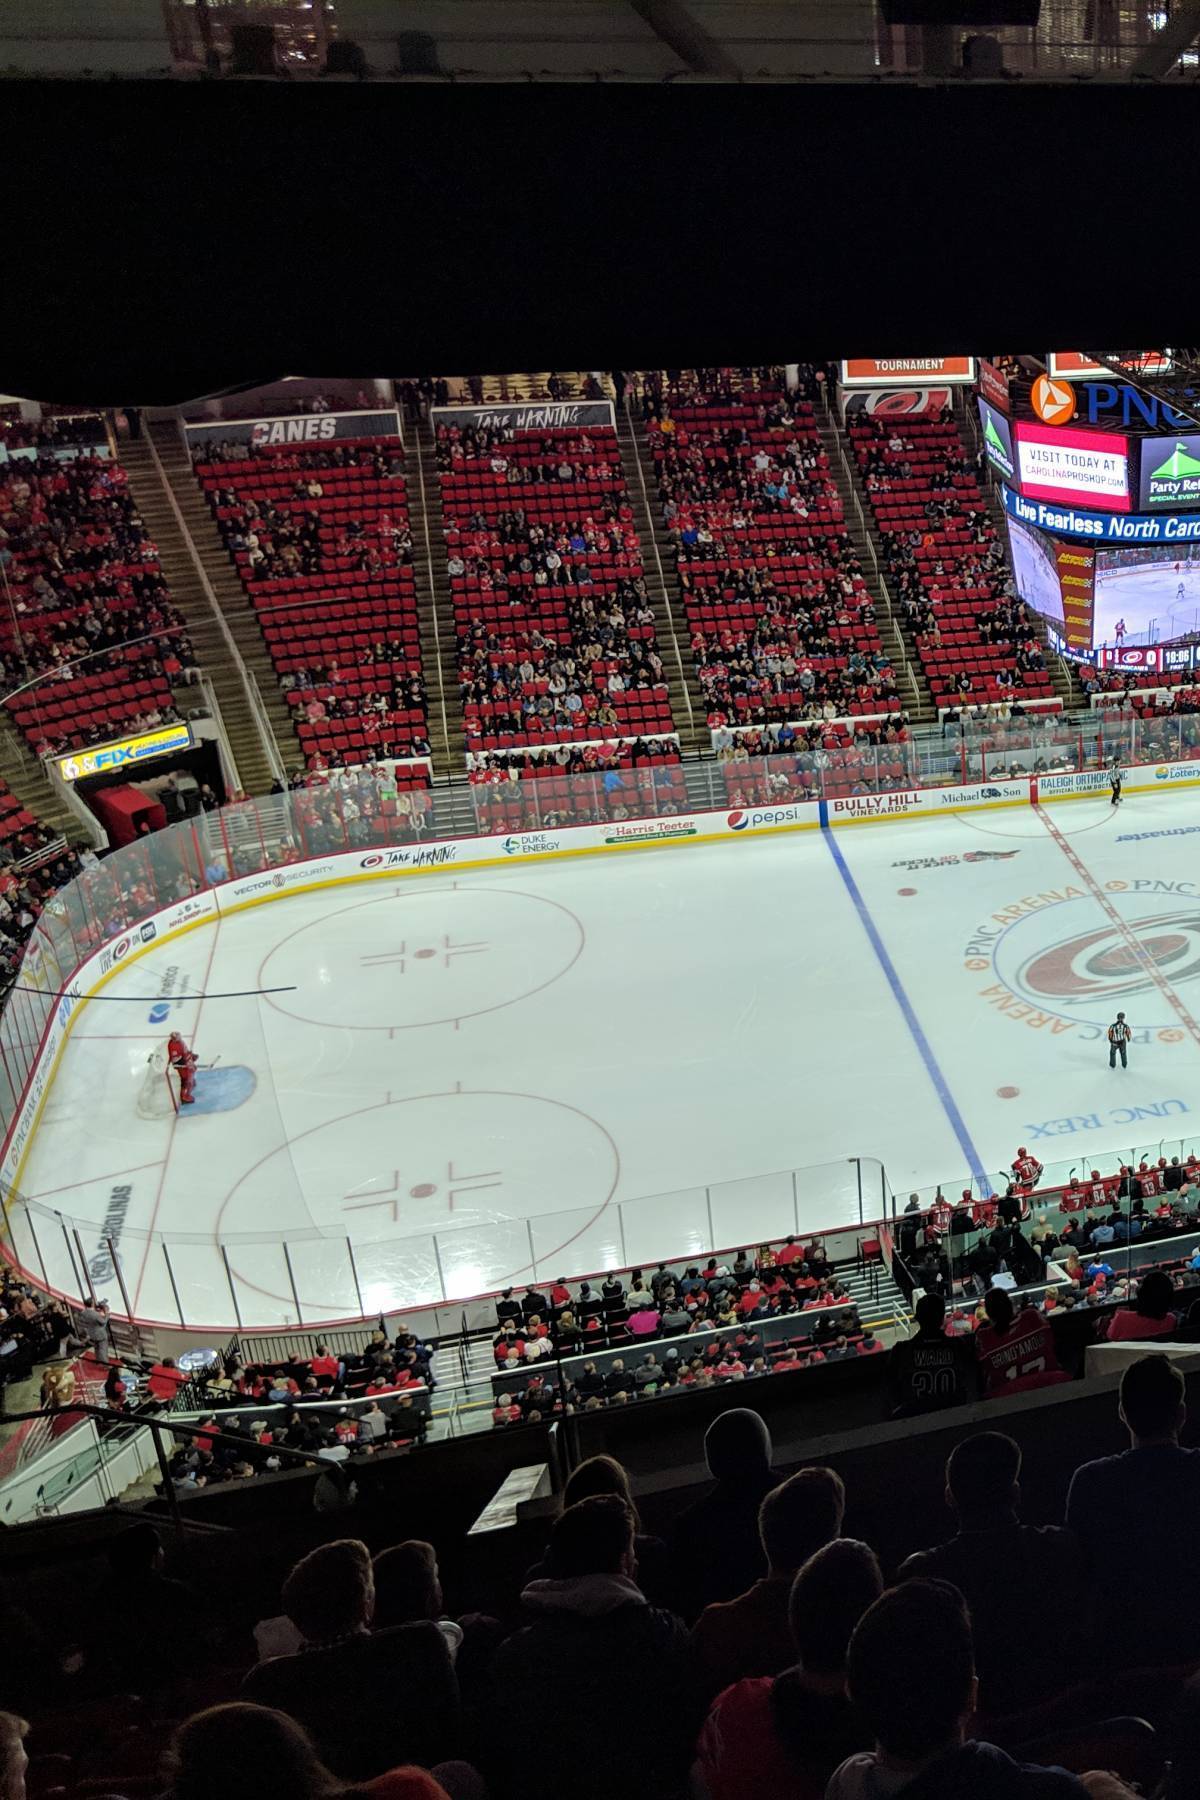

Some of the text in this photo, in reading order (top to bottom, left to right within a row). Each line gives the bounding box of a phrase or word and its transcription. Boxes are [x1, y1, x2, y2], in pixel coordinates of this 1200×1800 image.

[875, 358, 945, 371] TOURNAMENT
[474, 410, 511, 429] TAKE
[254, 418, 336, 444] CANES
[1030, 449, 1061, 464] VISIT
[1065, 454, 1100, 469] TODAY
[1104, 460, 1116, 471] AT
[1150, 481, 1181, 494] Party
[1150, 494, 1176, 502] SPECIAL
[1178, 492, 1200, 500] EVENT
[1016, 496, 1037, 521] Live
[1039, 506, 1104, 535] Fearless
[1108, 518, 1160, 537] North
[1146, 650, 1156, 665] 0
[1166, 650, 1190, 664] 19:06
[96, 746, 136, 768] FIX
[1041, 776, 1074, 789] RALEIGH
[834, 793, 922, 812] BULLY HILL
[942, 788, 1021, 804] Michael Son
[752, 808, 798, 827] pepsi
[850, 805, 908, 817] VINEYARDS
[616, 821, 695, 836] Harris Teeter
[521, 834, 547, 844] DUKE
[522, 840, 560, 853] ENERGY
[386, 850, 411, 864] TAKE
[234, 865, 334, 896] VECTOR SECURITY
[1132, 880, 1196, 894] PNC
[992, 884, 1086, 926] ARENA
[965, 925, 1003, 958] PNC
[977, 984, 1077, 1034] ARENA
[1077, 1026, 1151, 1044] PC
[1022, 1098, 1192, 1140] UNC REX
[914, 1350, 954, 1367] WARD
[912, 1368, 957, 1400] 30
